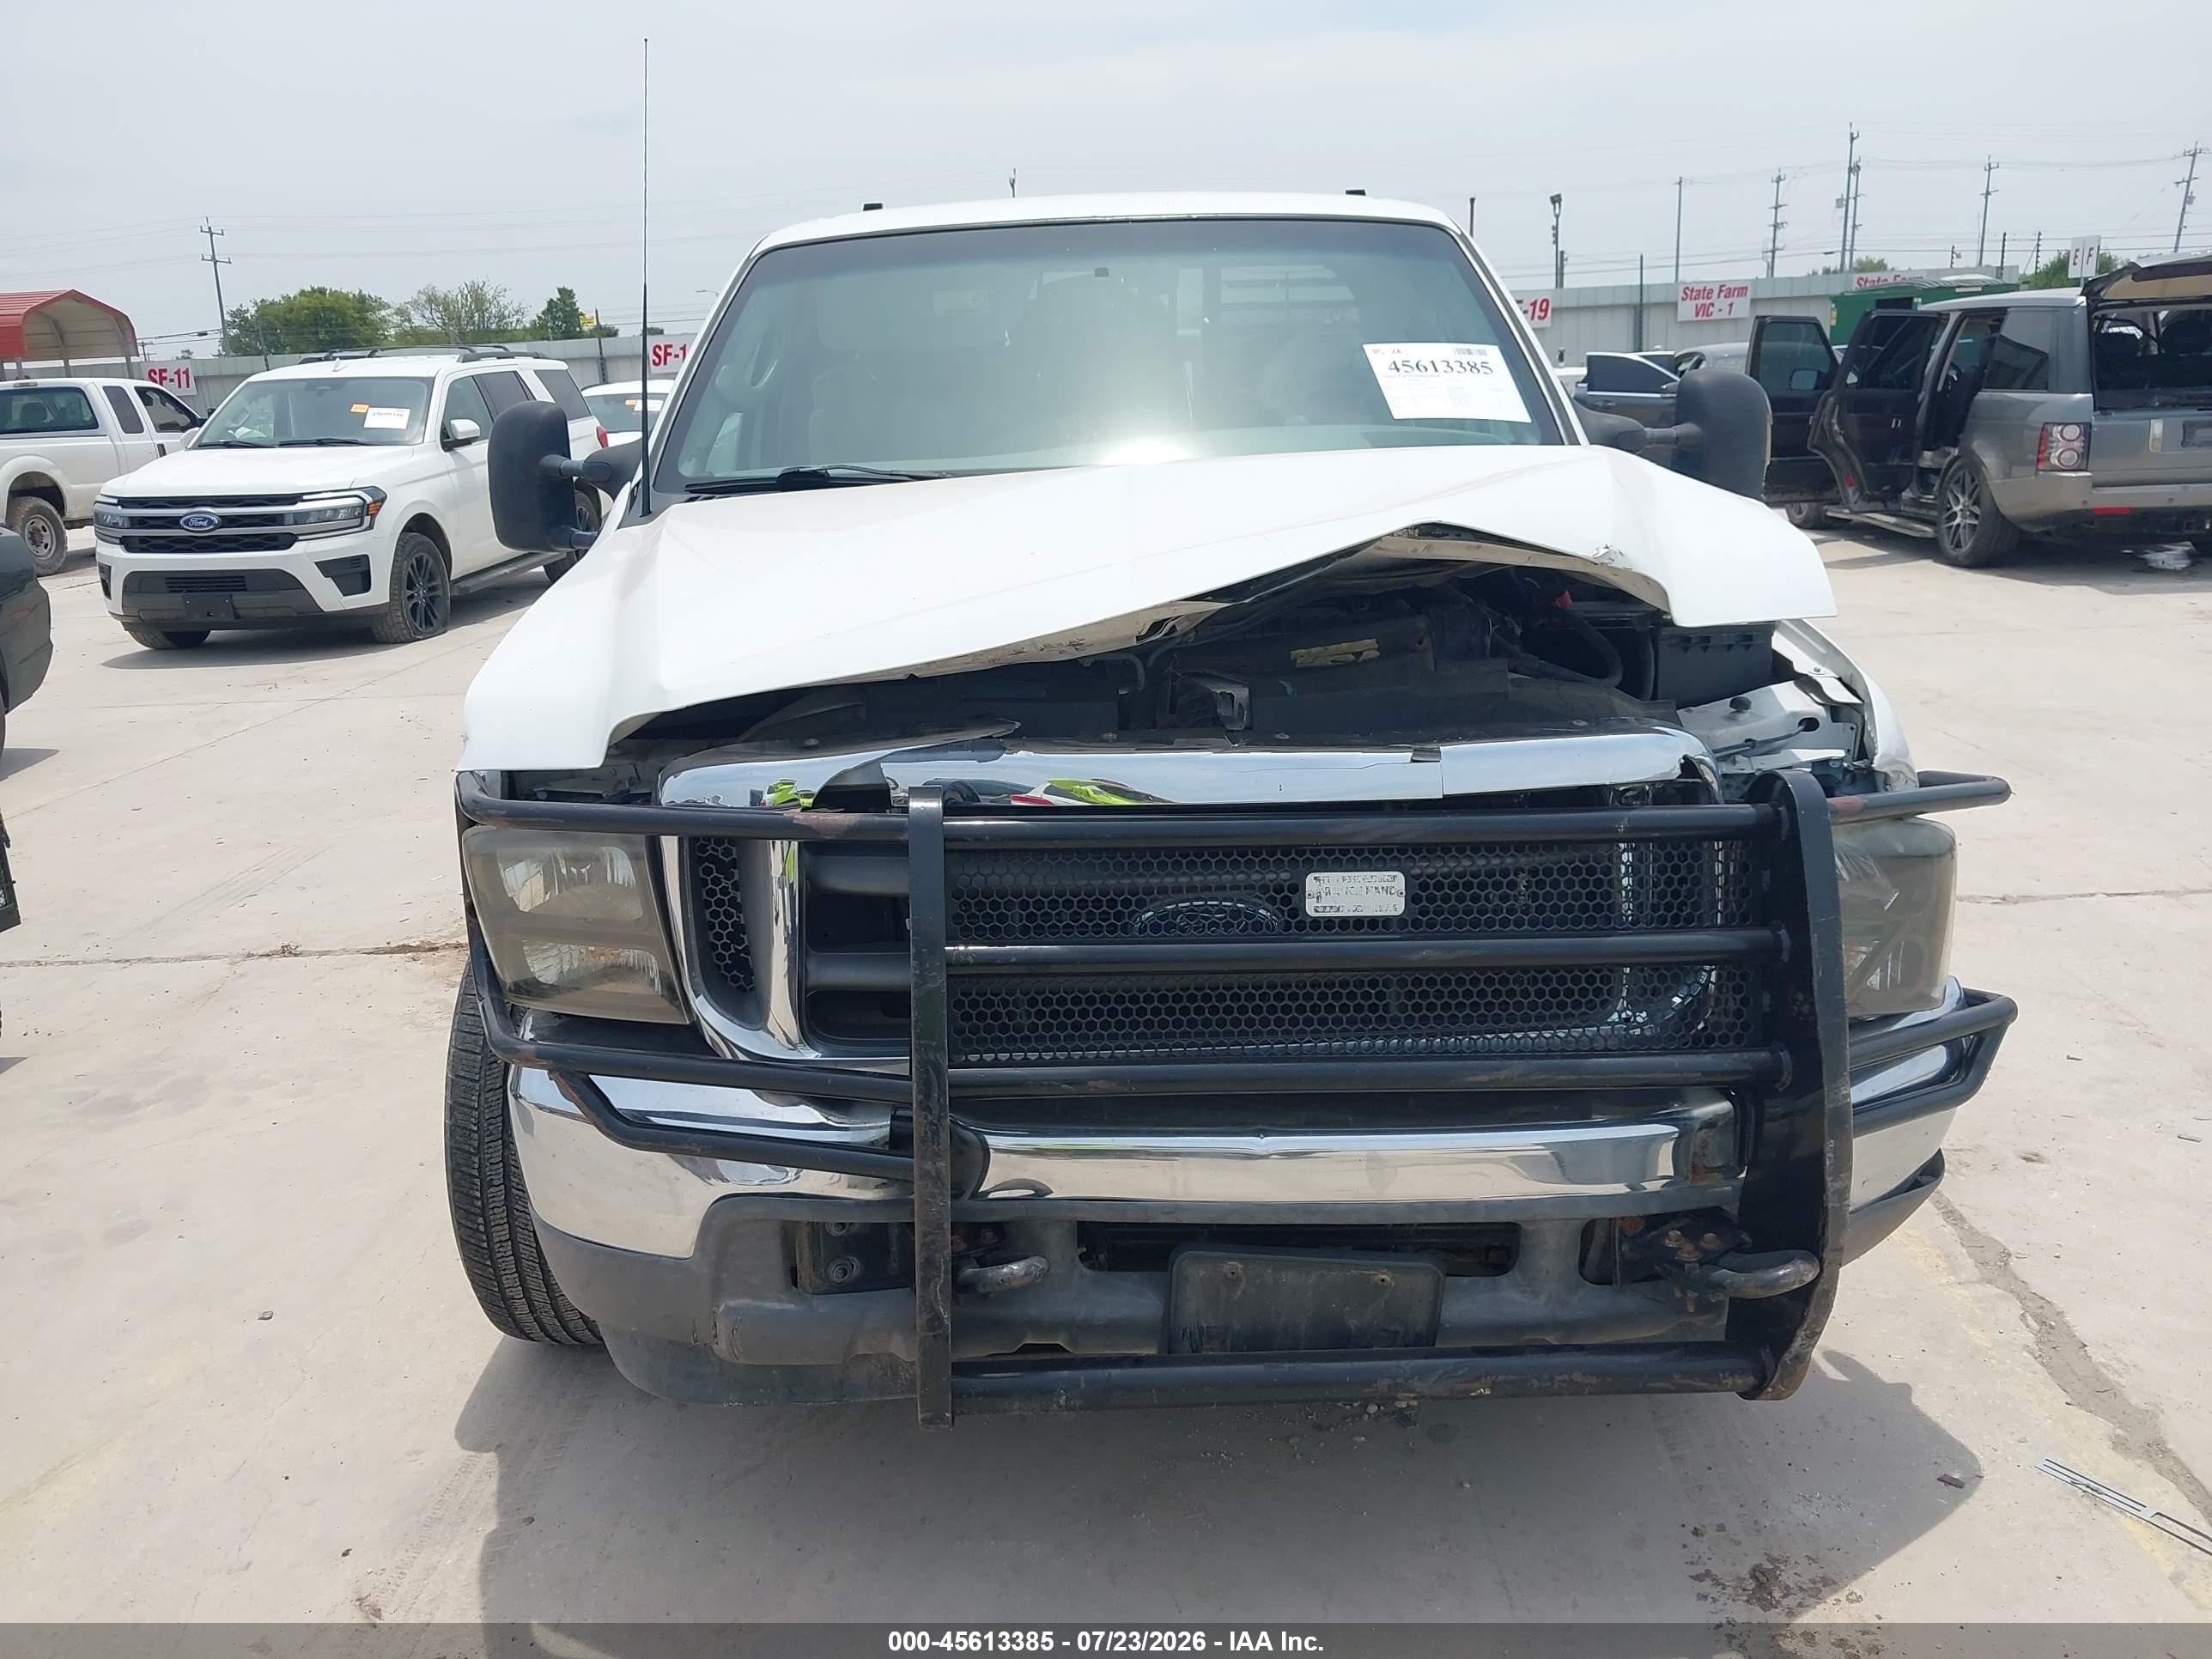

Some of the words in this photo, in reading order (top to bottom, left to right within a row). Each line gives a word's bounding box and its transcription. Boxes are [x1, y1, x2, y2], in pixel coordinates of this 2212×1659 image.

[2087, 246, 2094, 264] F
[1681, 286, 1714, 301] State
[1717, 284, 1748, 300] Farm
[1694, 302, 1715, 318] VIC
[1728, 302, 1734, 316] 1
[1388, 359, 1493, 375] 45613385
[148, 367, 190, 389] SF-11
[189, 517, 210, 526] Ford
